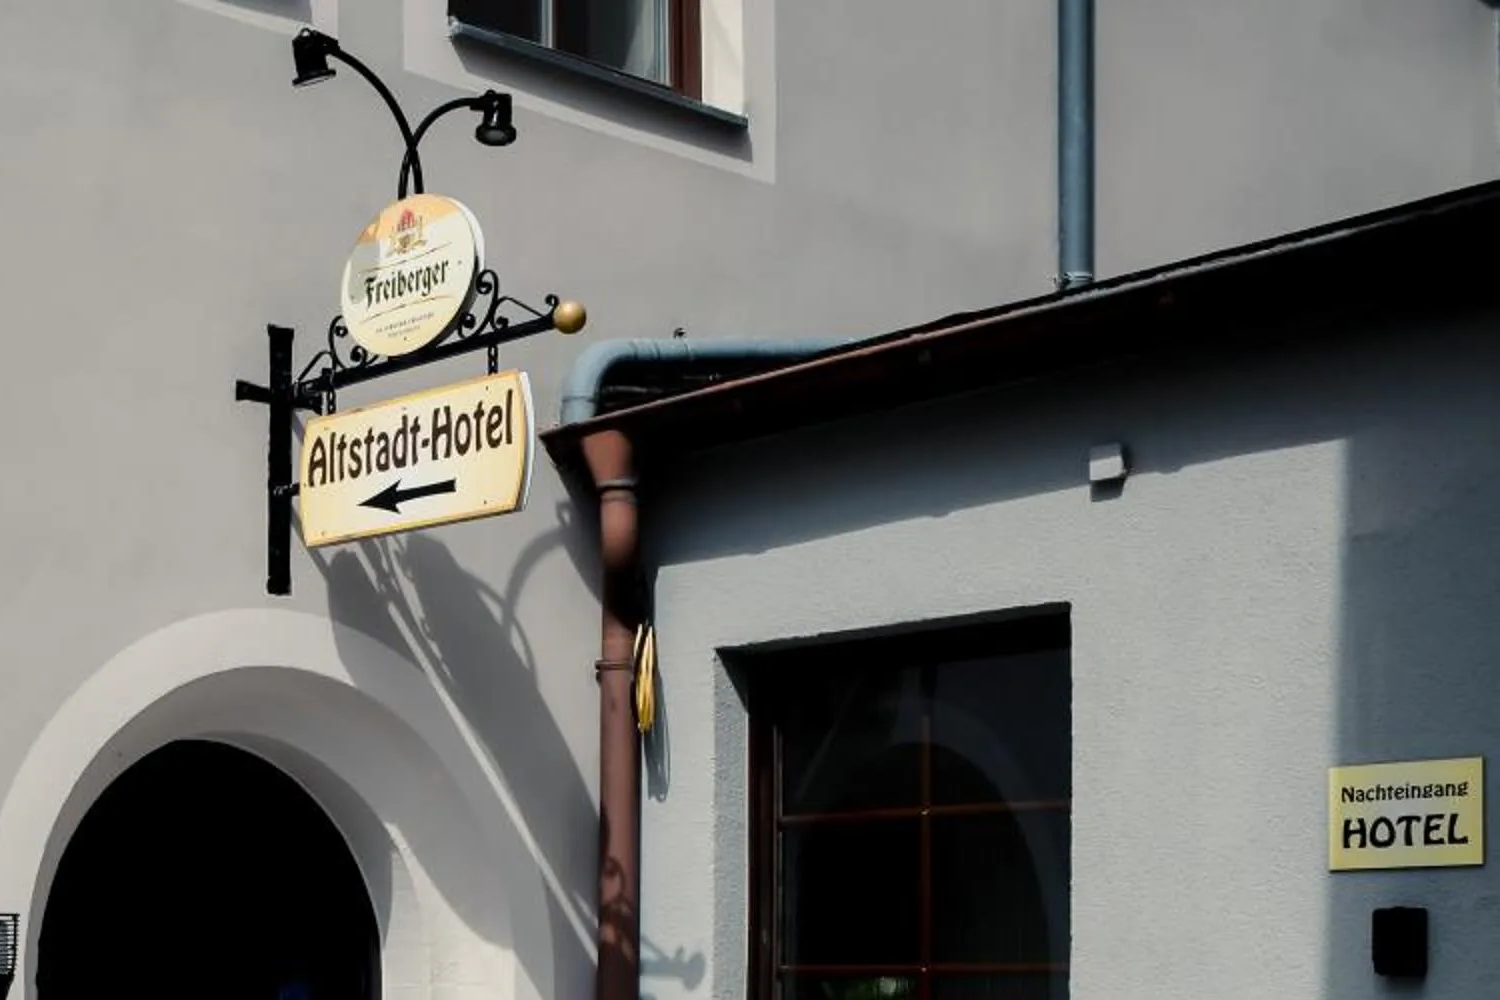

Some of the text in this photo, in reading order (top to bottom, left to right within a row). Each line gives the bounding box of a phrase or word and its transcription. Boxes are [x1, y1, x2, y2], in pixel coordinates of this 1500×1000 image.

[364, 260, 449, 310] Freiberger
[308, 388, 513, 487] Altstadt-Hotel
[1341, 780, 1469, 803] Nachteingang
[1343, 813, 1469, 849] HOTEL
